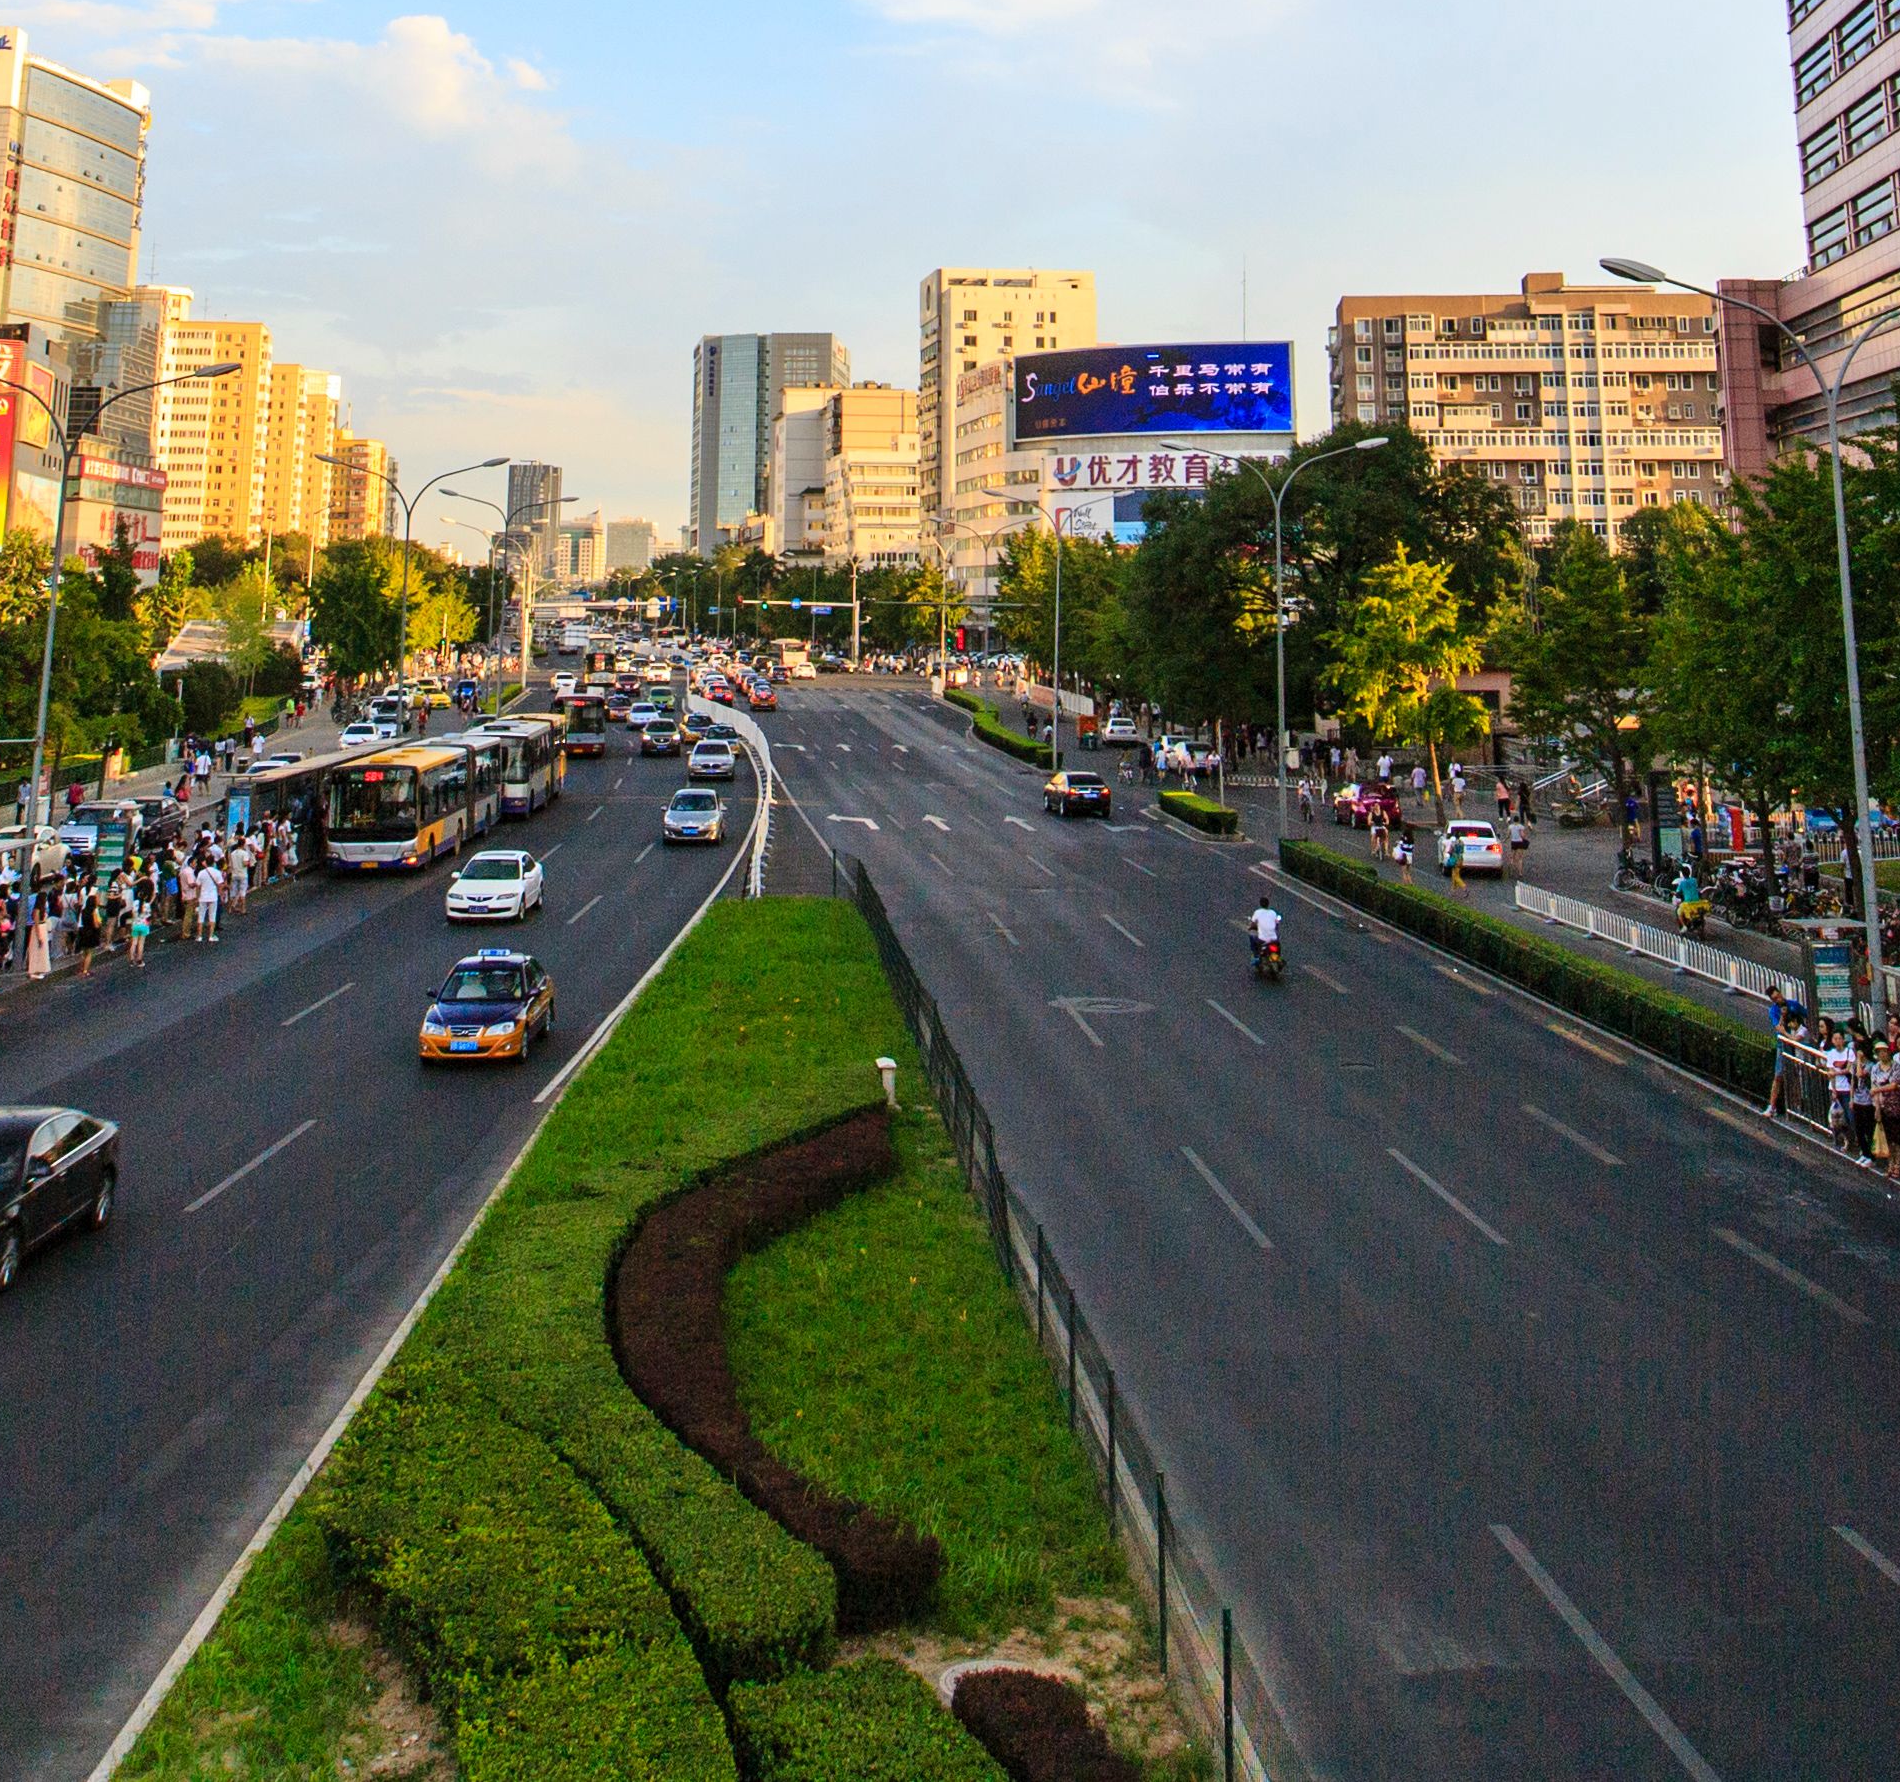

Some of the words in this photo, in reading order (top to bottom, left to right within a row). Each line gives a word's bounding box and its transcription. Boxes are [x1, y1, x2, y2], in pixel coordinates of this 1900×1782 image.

[1148, 363, 1274, 377] 千里马常有
[1148, 382, 1274, 396] 伯乐不常有
[1087, 454, 1211, 486] 优才教育
